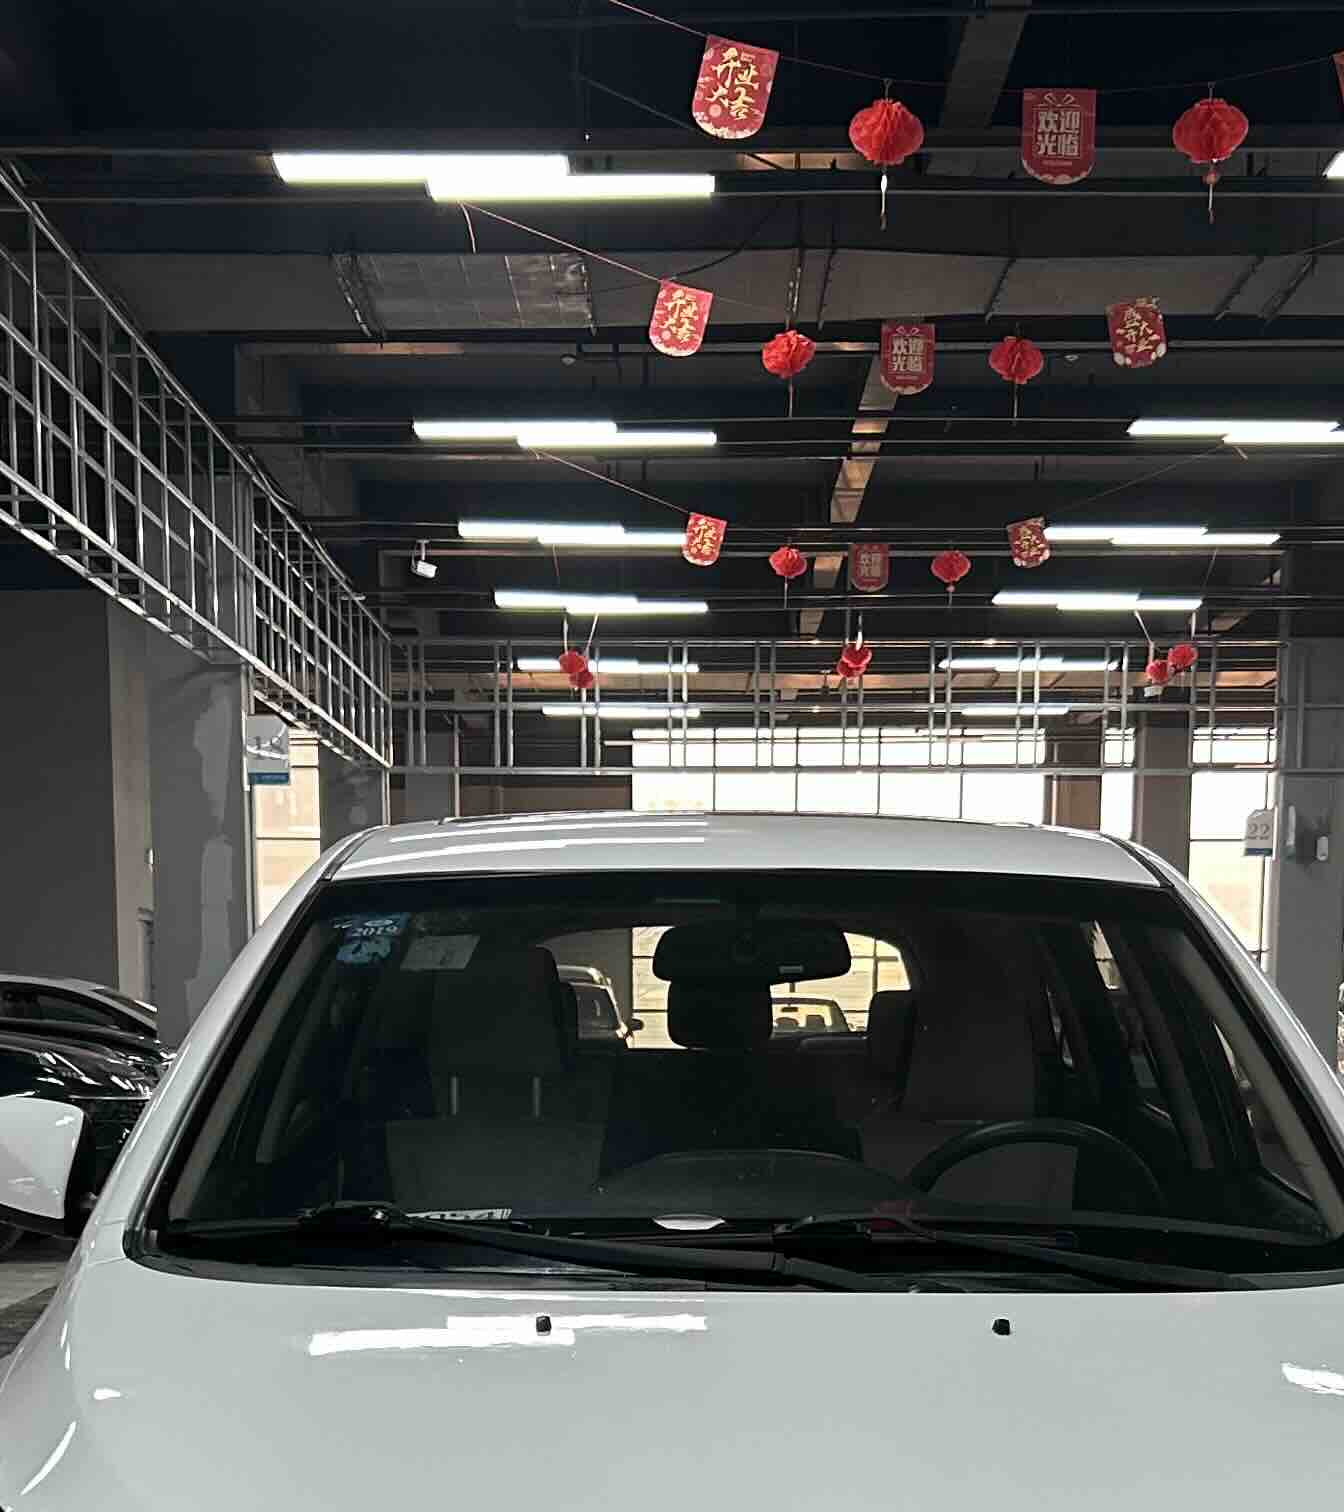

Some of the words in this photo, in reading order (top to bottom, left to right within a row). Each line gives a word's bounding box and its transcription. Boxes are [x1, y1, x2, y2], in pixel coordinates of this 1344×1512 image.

[1037, 111, 1080, 133] 欢迎
[1037, 133, 1080, 156] 光临
[1248, 823, 1271, 840] 22
